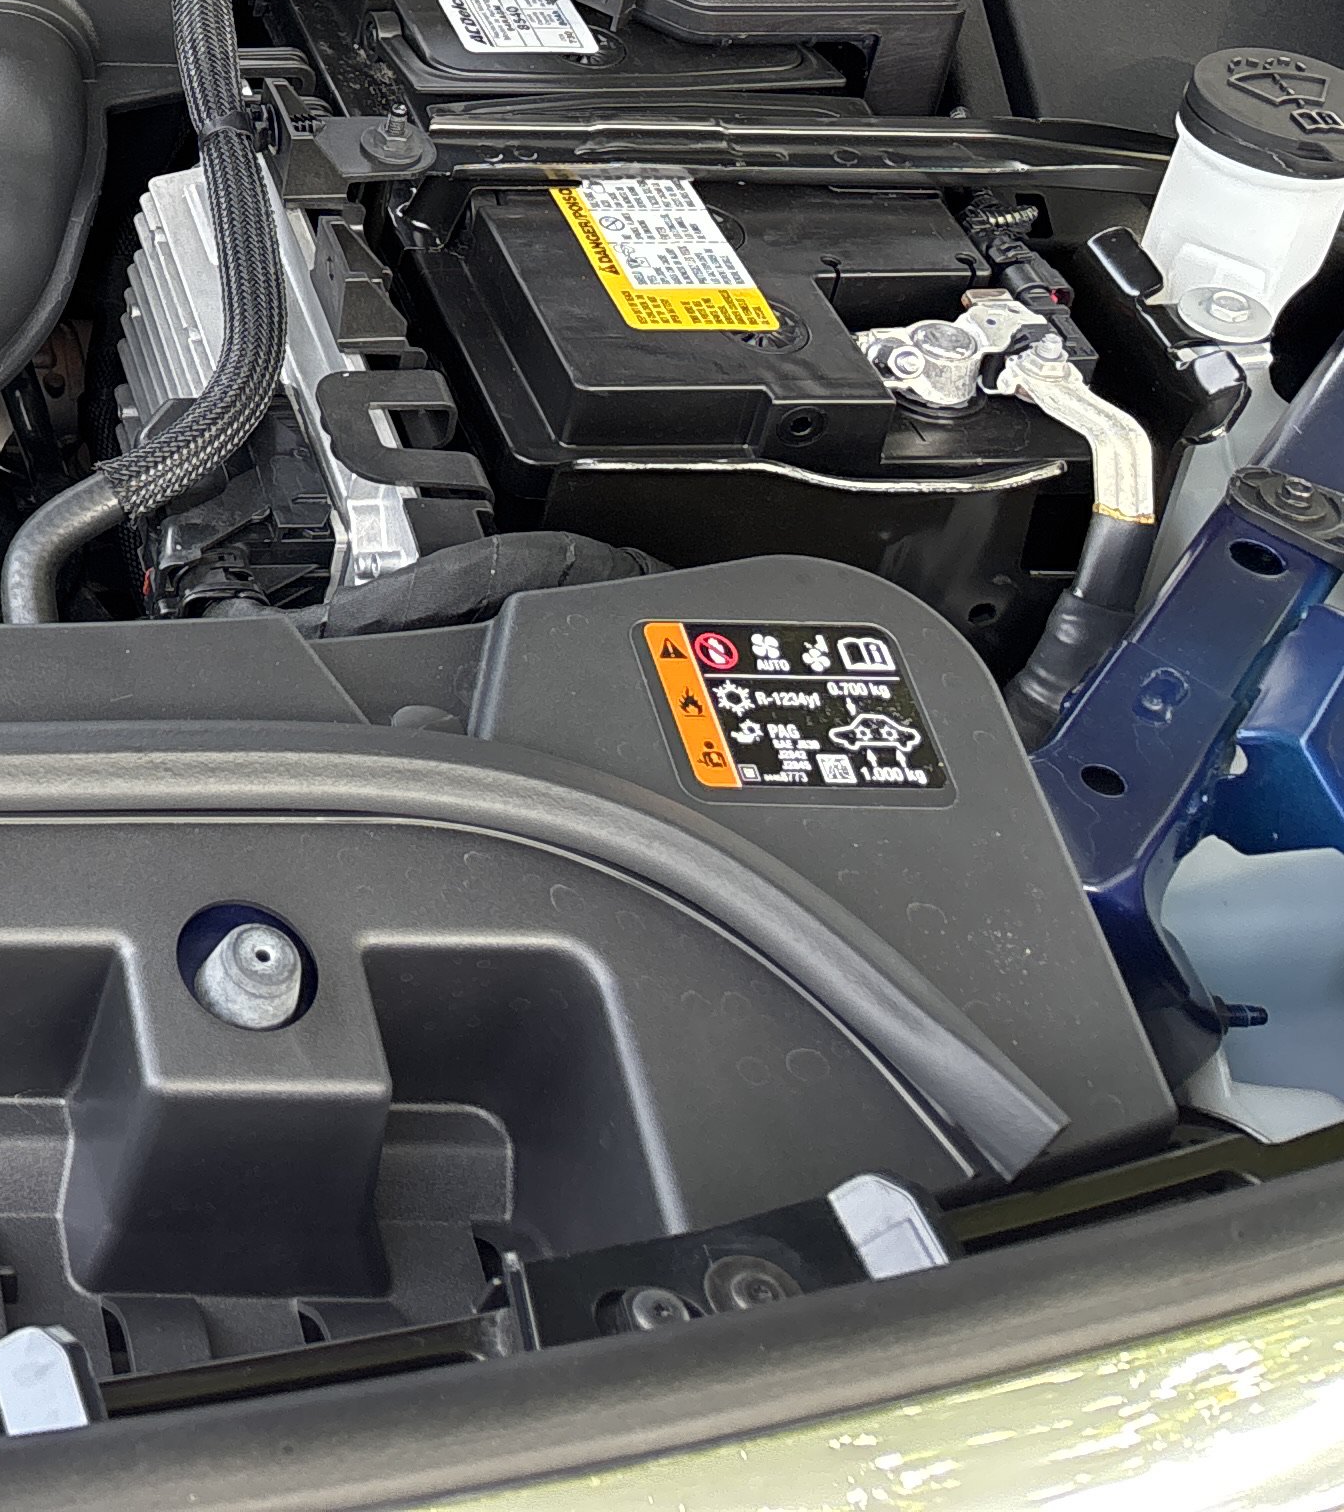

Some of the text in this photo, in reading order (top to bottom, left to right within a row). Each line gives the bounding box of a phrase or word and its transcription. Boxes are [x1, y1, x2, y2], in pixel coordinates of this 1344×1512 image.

[558, 187, 615, 265] DANGER/POISO
[756, 658, 791, 671] AUTO
[826, 682, 891, 699] 0.700 kg
[766, 723, 800, 739] PAG
[860, 767, 928, 785] 1.000 kg
